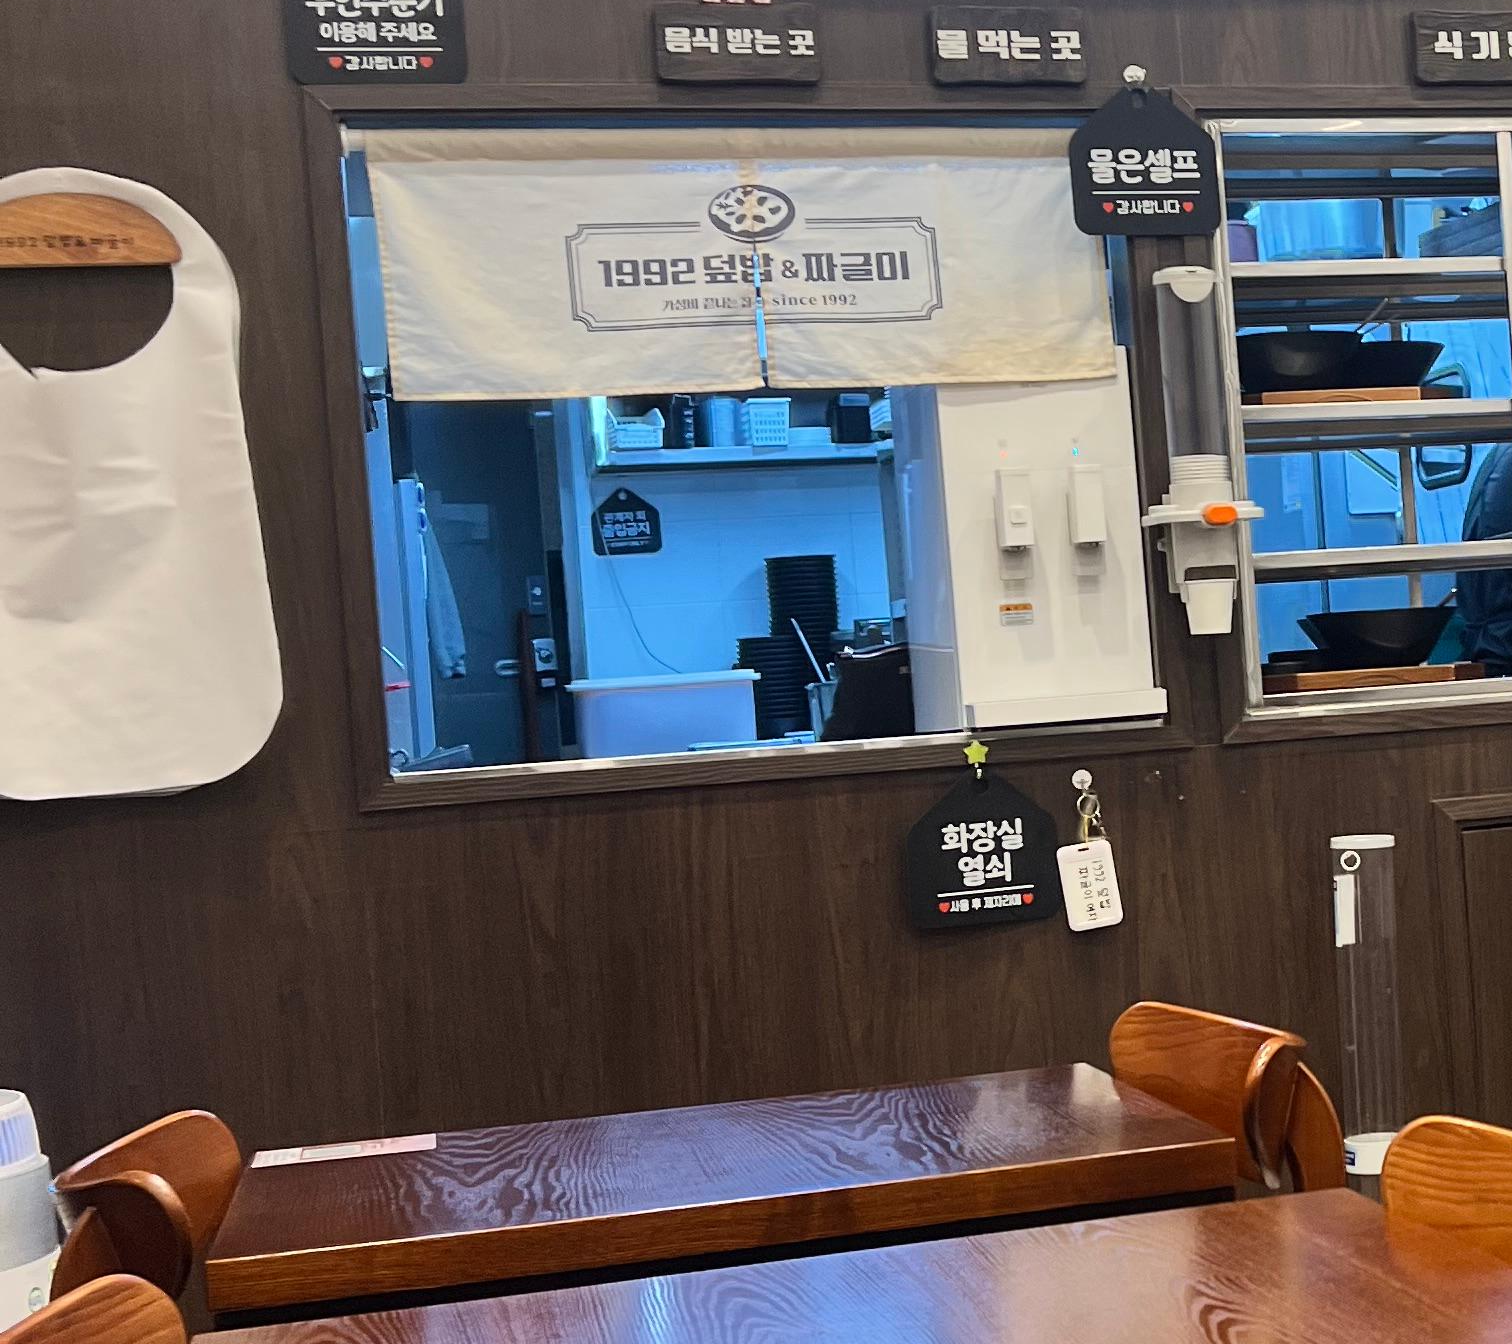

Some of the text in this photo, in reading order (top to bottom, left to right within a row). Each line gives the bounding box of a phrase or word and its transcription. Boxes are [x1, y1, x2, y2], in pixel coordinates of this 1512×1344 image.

[319, 22, 437, 43] 이용해 주세요
[665, 27, 815, 56] 음식 받는 곳
[937, 29, 1081, 60] 물 먹는 곳
[343, 55, 418, 70] 감사합니다
[1087, 148, 1201, 184] 물은셀프
[1115, 199, 1180, 214] 감사합니다
[598, 258, 695, 288] 1992
[781, 260, 799, 280] &
[772, 293, 858, 306] since 1992
[941, 817, 1024, 853] 화장실
[957, 851, 1013, 887] 열쇠
